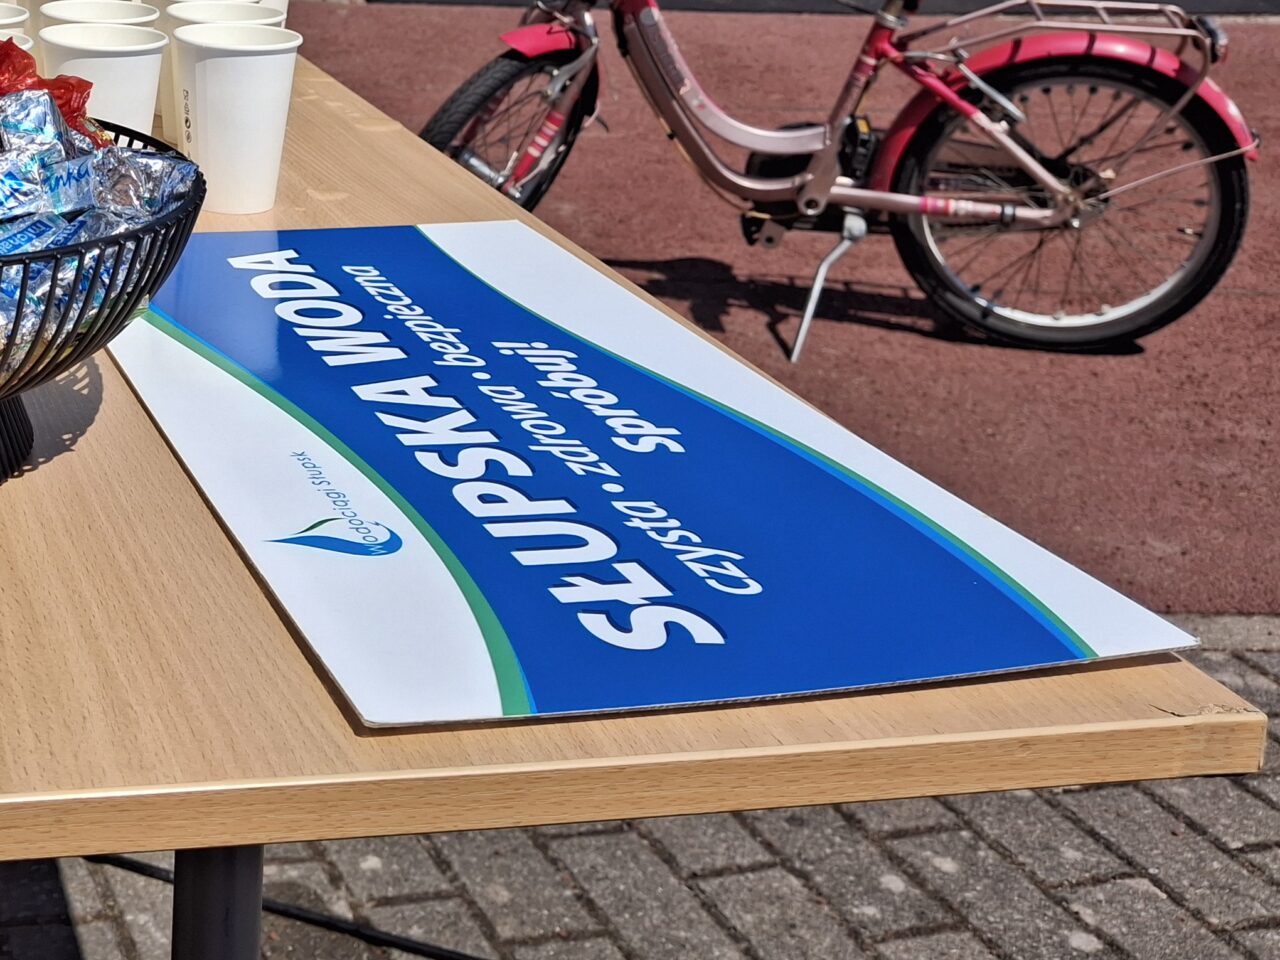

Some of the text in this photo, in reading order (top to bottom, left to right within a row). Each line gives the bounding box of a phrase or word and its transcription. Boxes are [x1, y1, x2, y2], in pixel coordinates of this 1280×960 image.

[226, 249, 726, 651] SŁUPSKA WODA
[289, 451, 384, 556] Wodociągi Słupsk
[341, 265, 764, 596] czysta zdrowa bezpieczna
[491, 341, 687, 453] Spróbuj!
